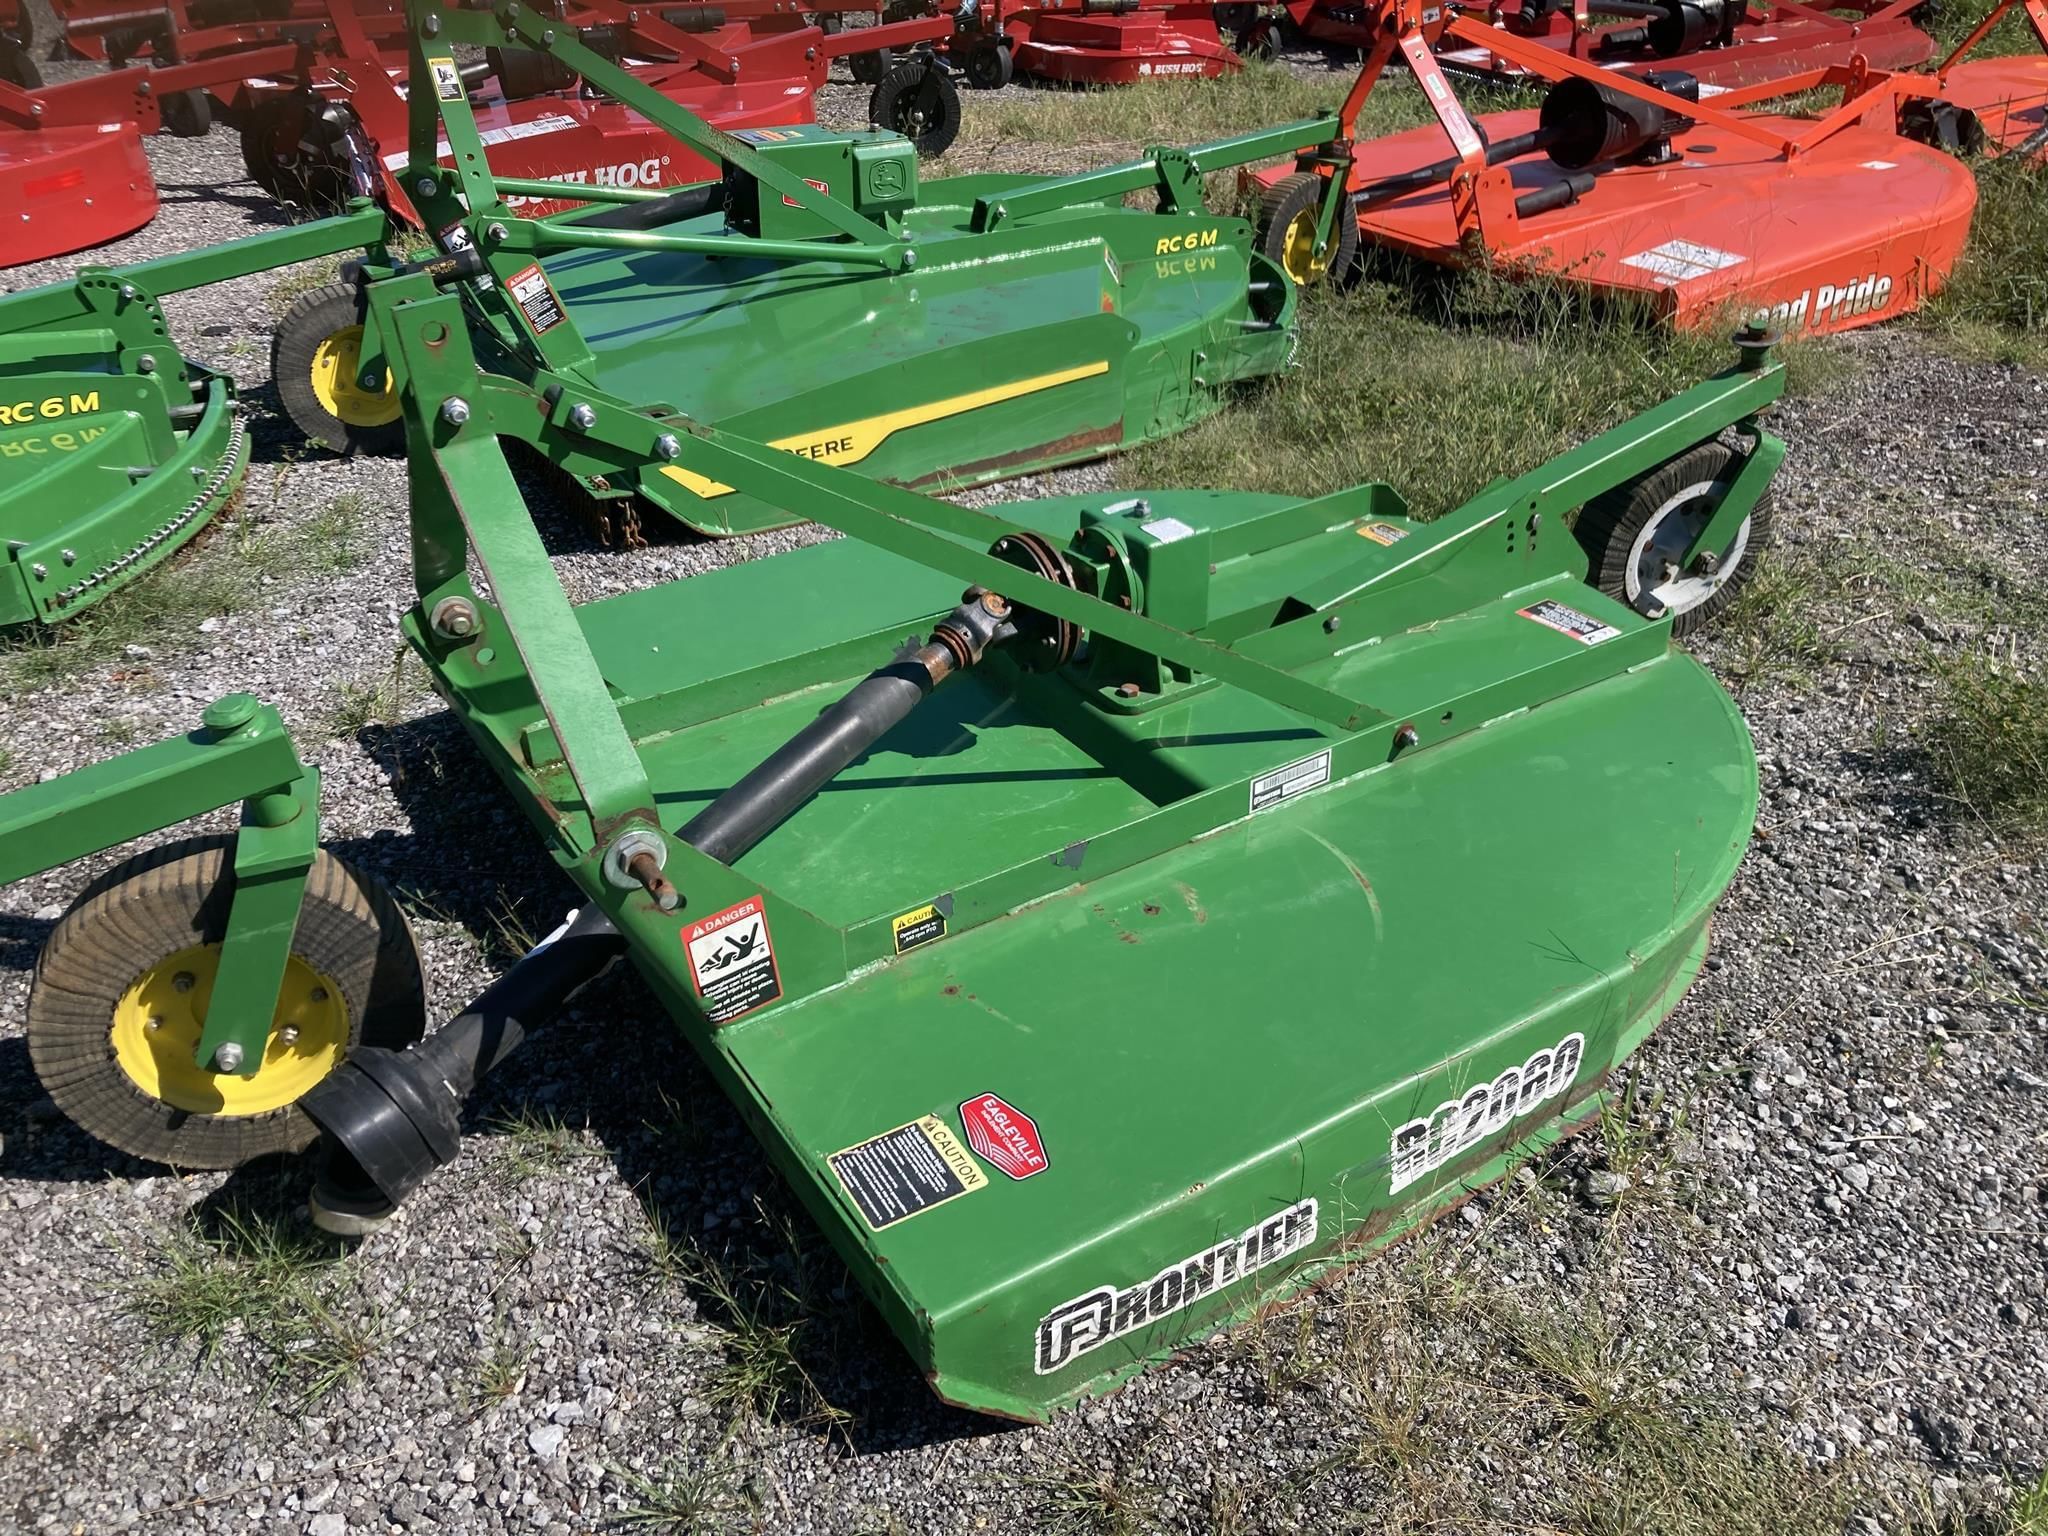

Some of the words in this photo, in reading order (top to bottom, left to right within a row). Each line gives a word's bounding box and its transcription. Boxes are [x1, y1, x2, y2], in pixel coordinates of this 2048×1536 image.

[1154, 63, 1181, 74] BUSH
[1811, 272, 1892, 328] Pride
[783, 436, 854, 460] EERE
[704, 903, 755, 931] DANGER
[702, 973, 742, 994] Entanglement
[748, 961, 770, 972] rotating
[726, 984, 743, 995] injury
[725, 998, 747, 1011] contact
[980, 1109, 1005, 1138] IMPLEMENT
[1002, 1136, 1025, 1162] COMPANY
[983, 1098, 1043, 1167] EAGLEVILLE
[932, 1131, 981, 1186] CAUTION
[1037, 1200, 1317, 1373] FRONTIER
